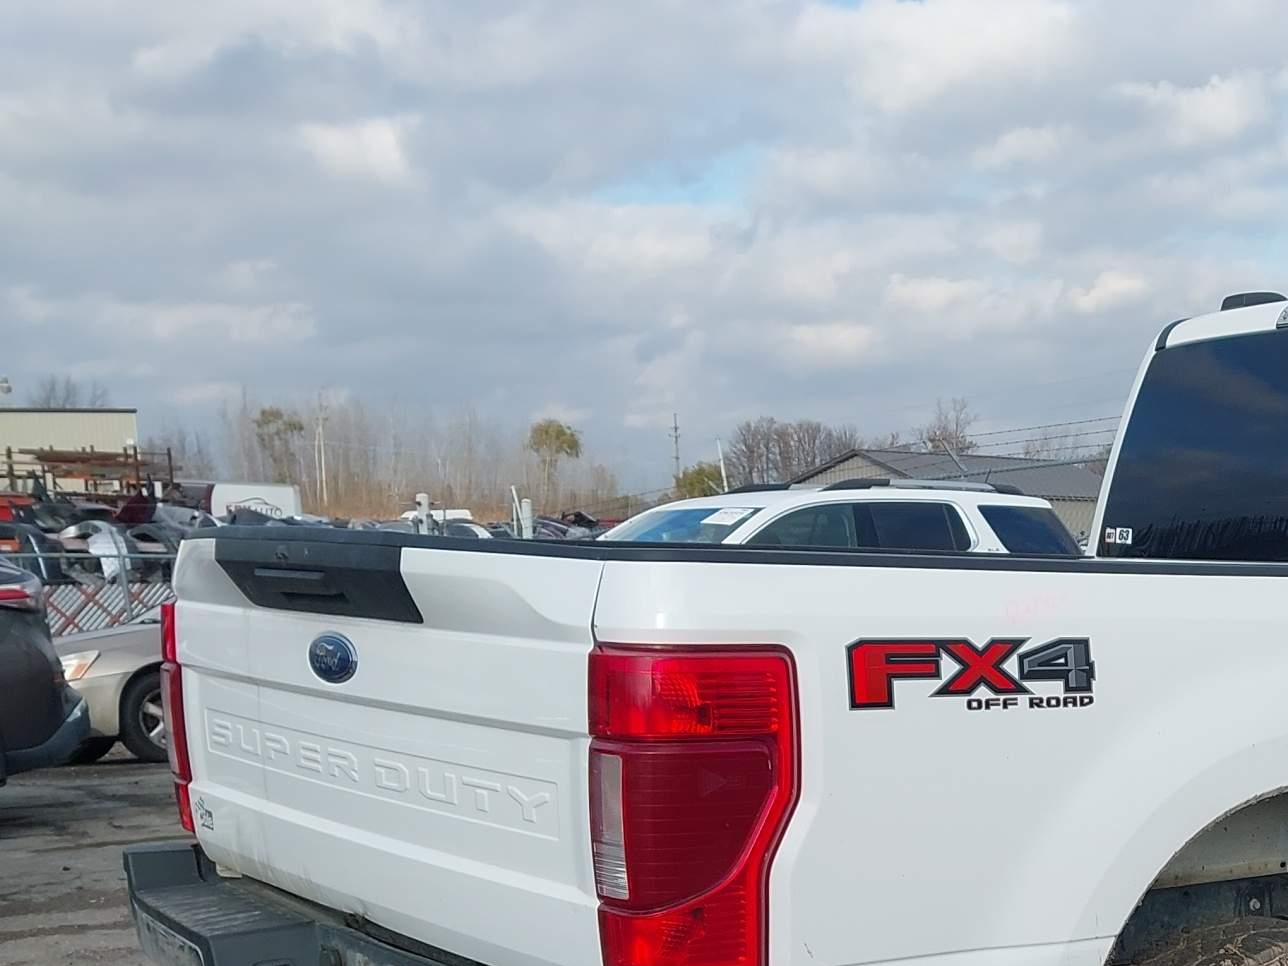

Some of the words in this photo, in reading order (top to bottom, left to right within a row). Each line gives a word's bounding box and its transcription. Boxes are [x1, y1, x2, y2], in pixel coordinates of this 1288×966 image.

[845, 637, 1096, 711] FX4
[966, 696, 1019, 710] OFF
[1028, 695, 1095, 709] ROAD
[209, 717, 361, 783] SUPER
[373, 756, 552, 824] DUTY
